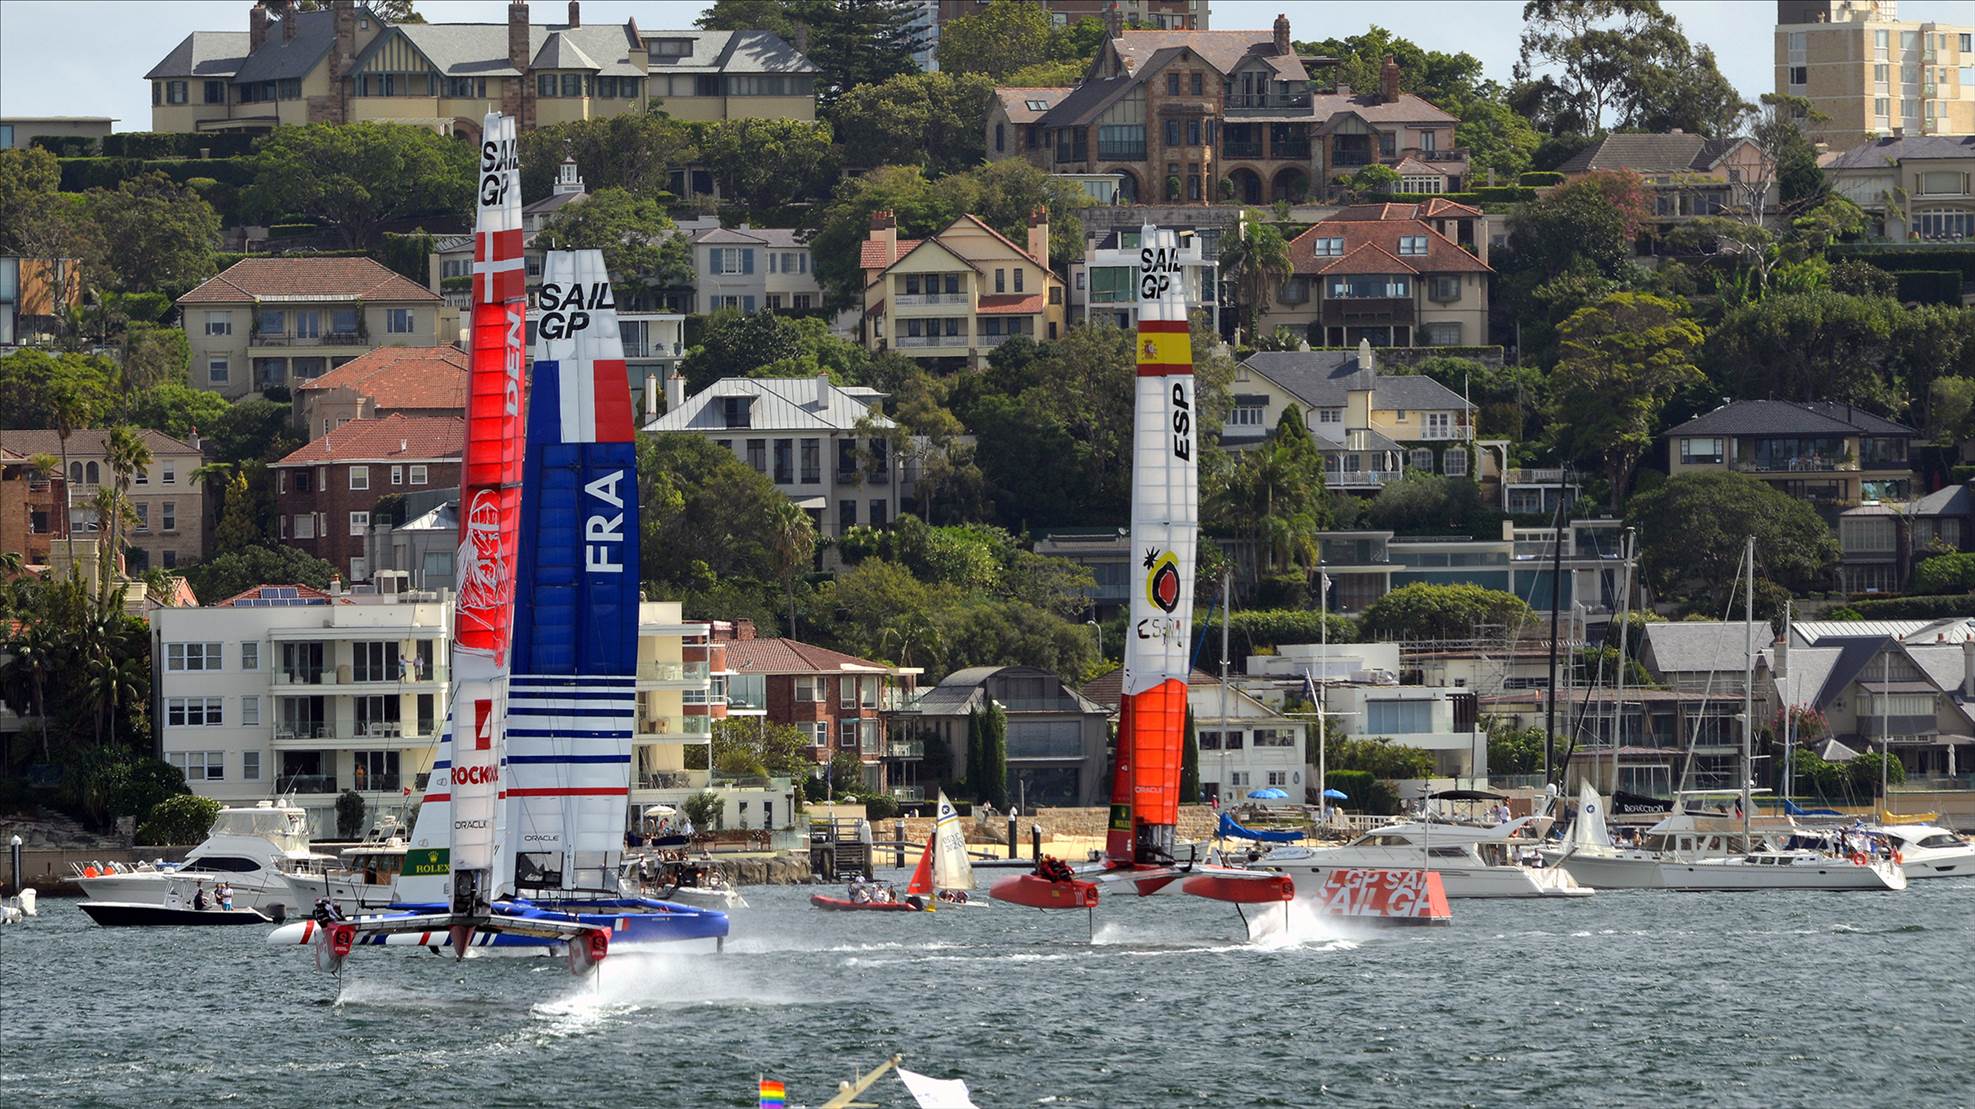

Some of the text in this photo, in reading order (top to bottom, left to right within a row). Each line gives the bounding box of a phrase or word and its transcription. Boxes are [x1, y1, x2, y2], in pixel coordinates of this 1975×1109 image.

[481, 140, 519, 173] SAIL
[481, 175, 508, 206] GP
[1140, 247, 1182, 273] SAIL
[539, 282, 615, 312] SAIL
[1141, 274, 1170, 299] GP
[539, 312, 590, 340] GP
[506, 311, 521, 417] DEN
[1172, 382, 1190, 462] ESP
[585, 470, 624, 573] FRA
[524, 834, 560, 842] ORACLE
[416, 864, 451, 873] ROLEX
